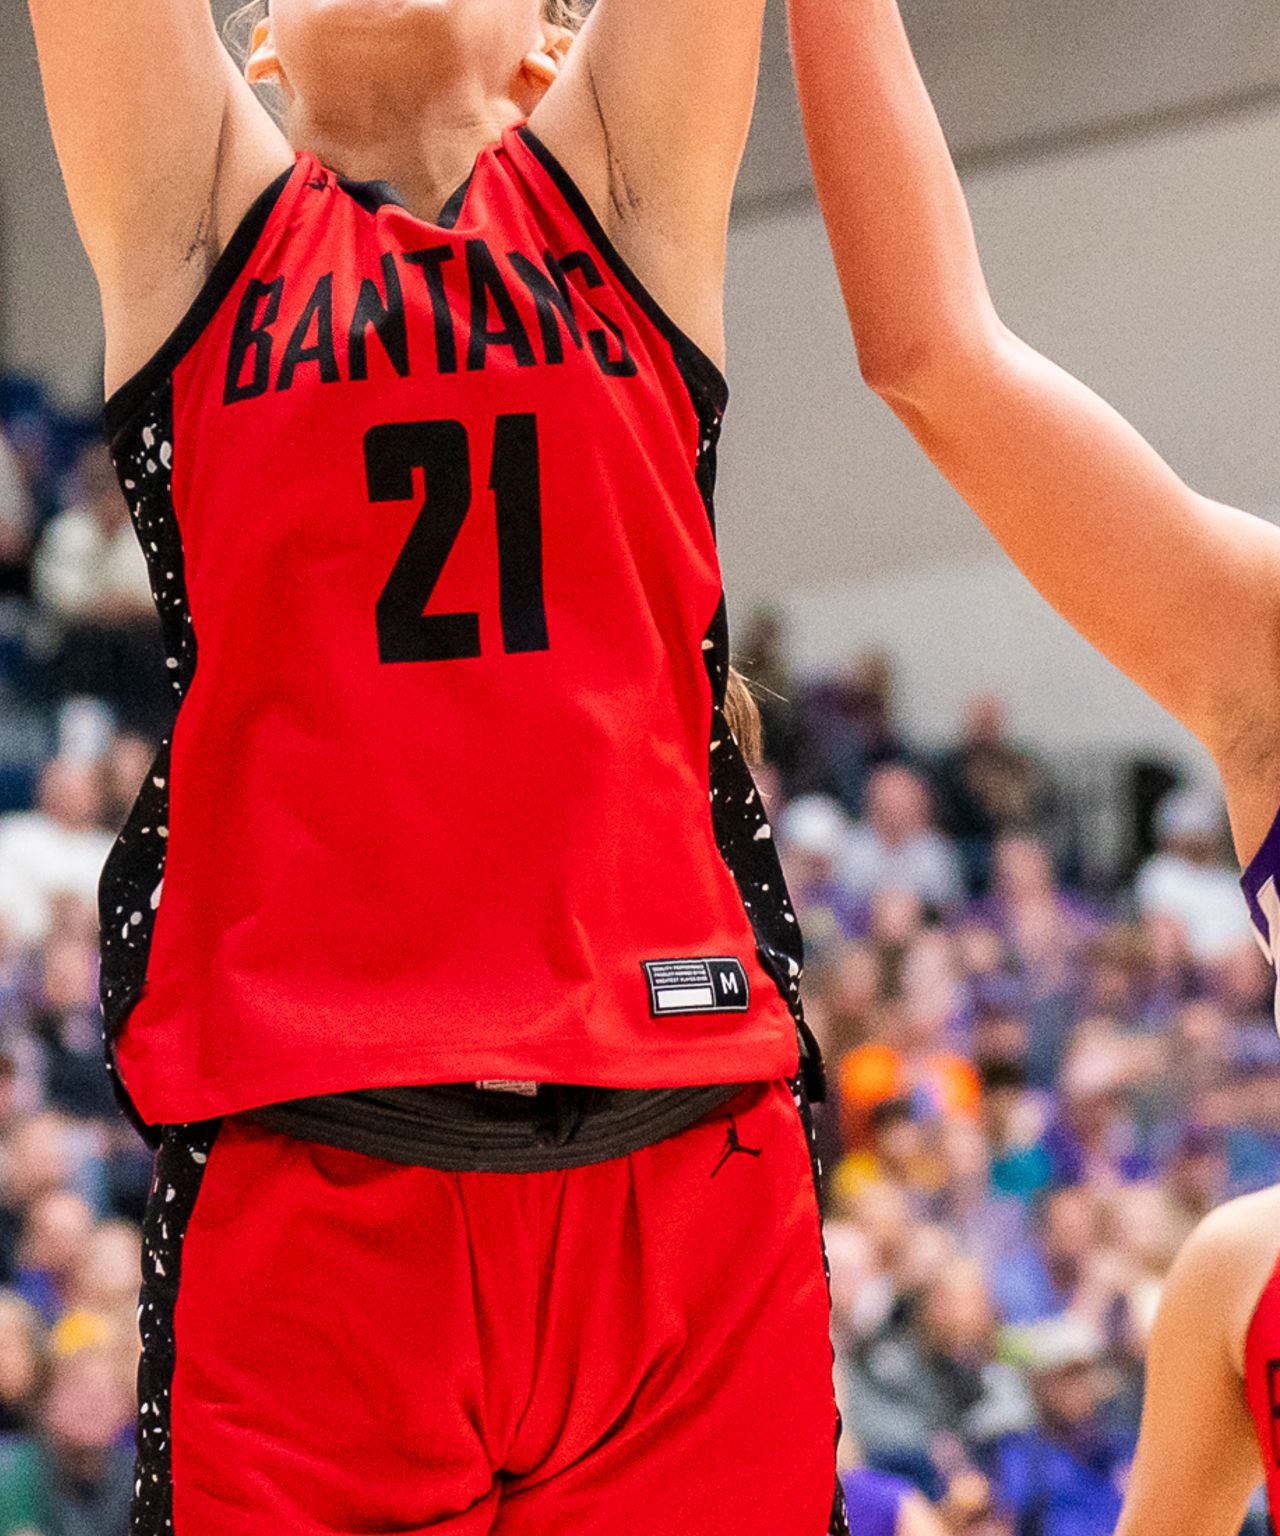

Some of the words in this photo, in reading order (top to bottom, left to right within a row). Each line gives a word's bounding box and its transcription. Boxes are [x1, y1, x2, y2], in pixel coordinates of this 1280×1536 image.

[223, 239, 638, 406] BANTAMS
[363, 412, 550, 664] 21
[720, 973, 738, 994] M
